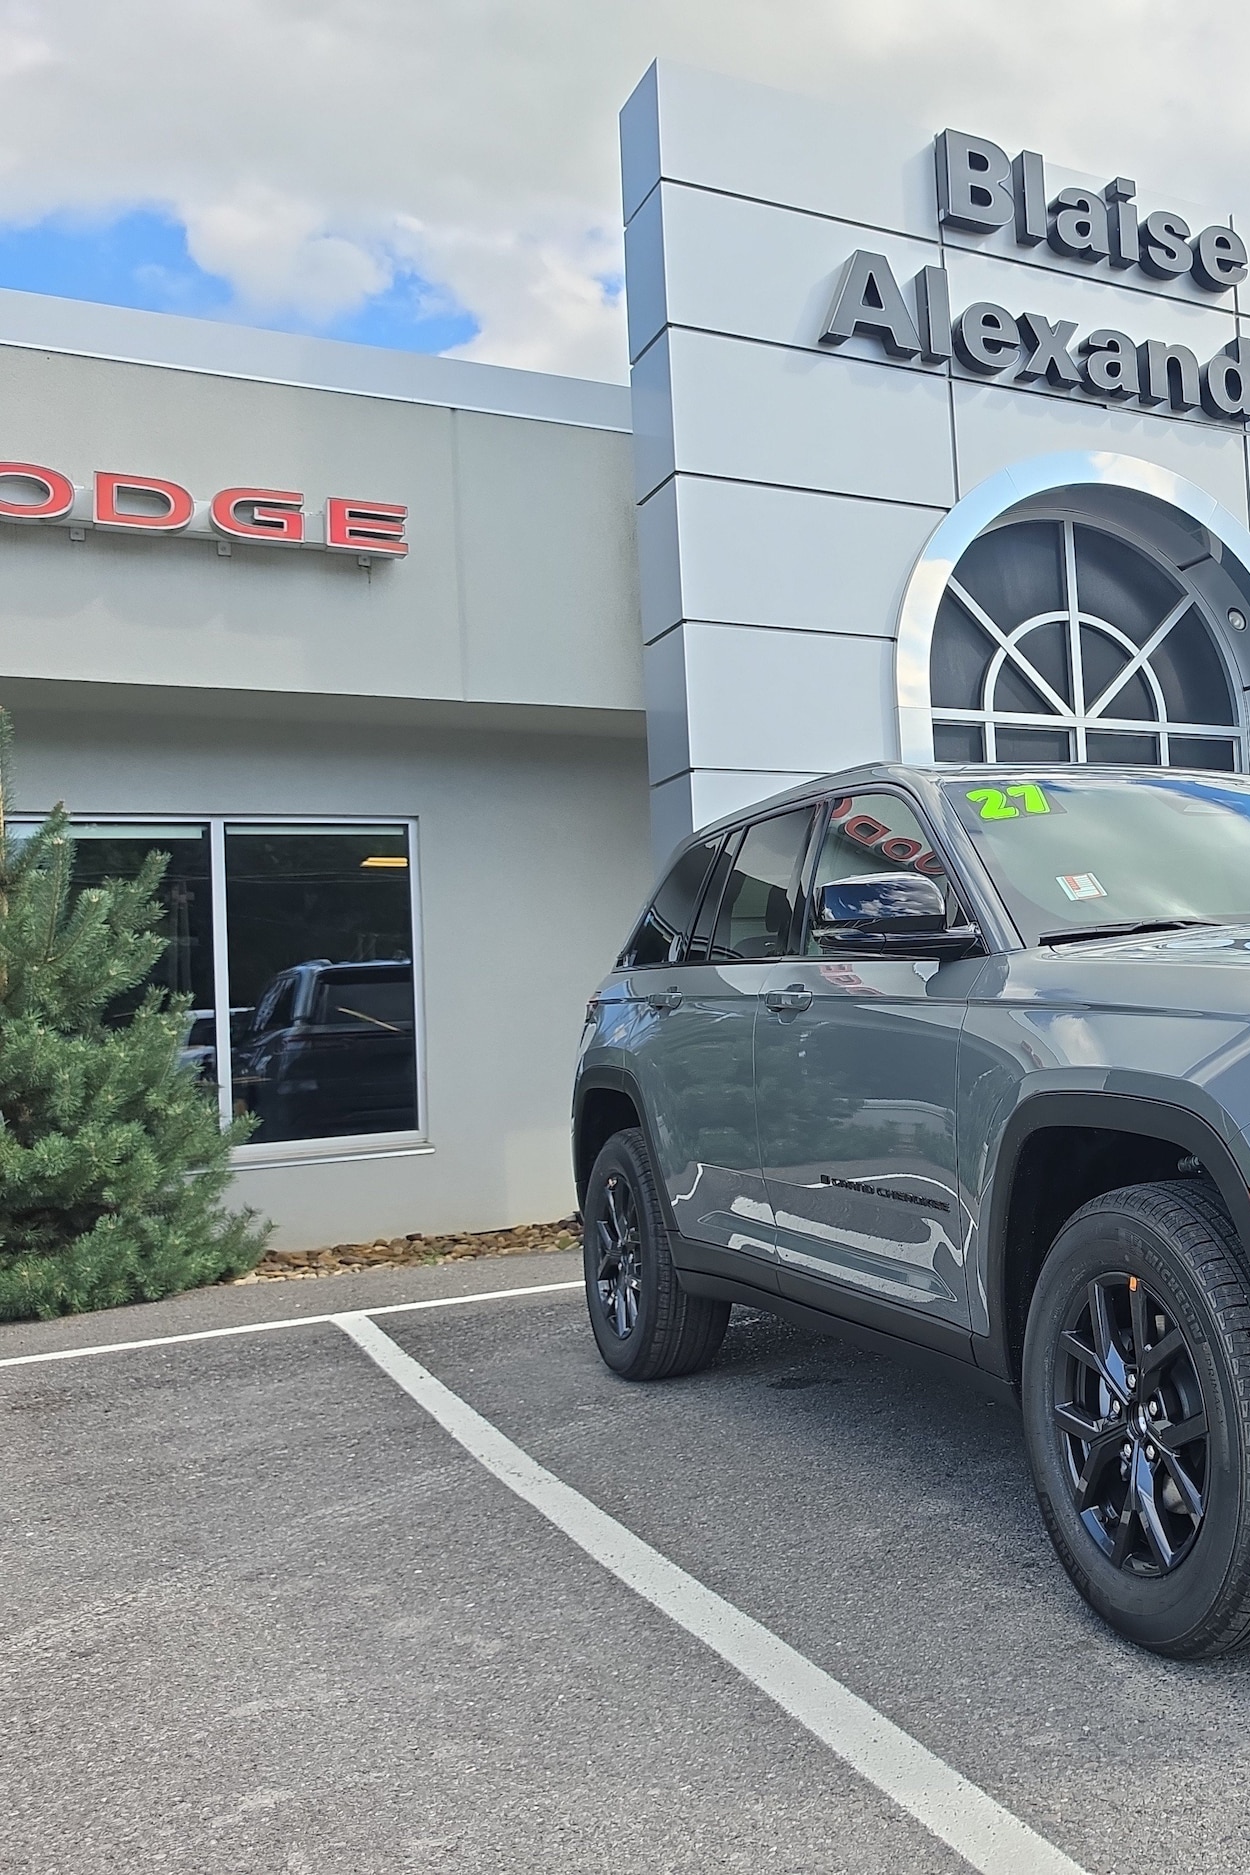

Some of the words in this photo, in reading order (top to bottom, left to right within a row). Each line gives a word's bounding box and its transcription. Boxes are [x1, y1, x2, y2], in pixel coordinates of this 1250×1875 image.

[936, 128, 1249, 292] Blaise
[966, 784, 1050, 820] 27
[832, 1178, 874, 1195] GRAND
[876, 1188, 950, 1212] CHEROKEE
[1143, 1252, 1203, 1338] MICHELIN
